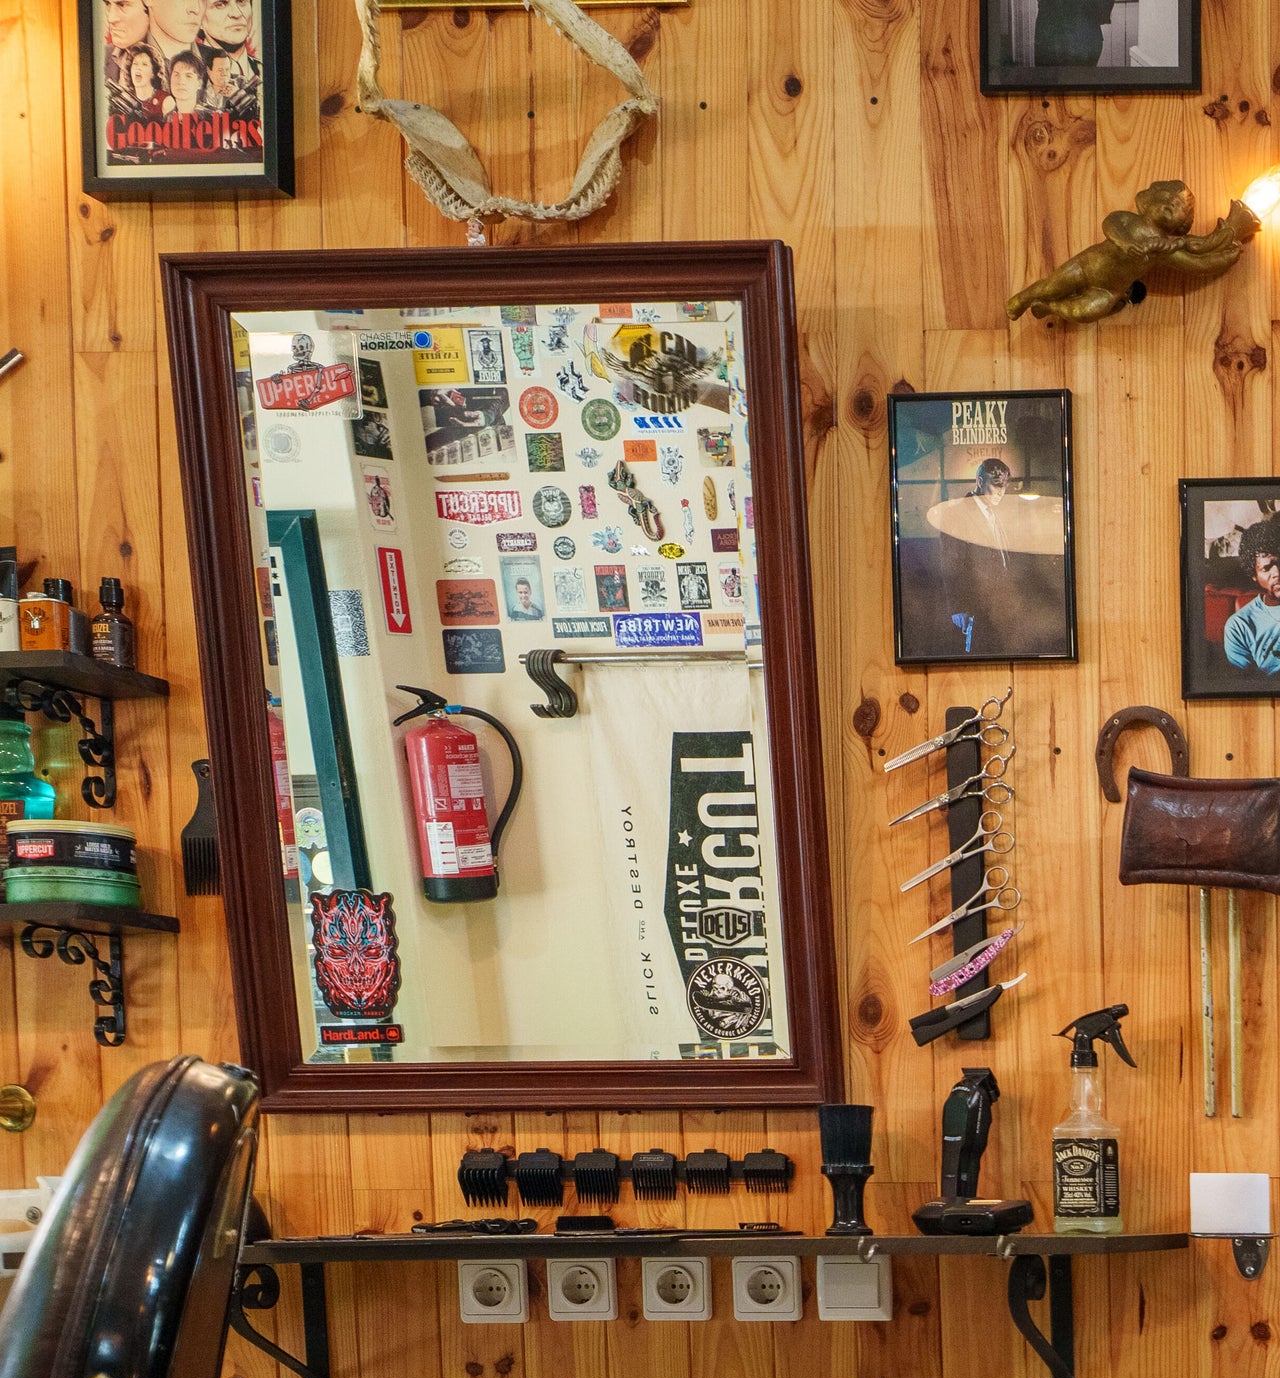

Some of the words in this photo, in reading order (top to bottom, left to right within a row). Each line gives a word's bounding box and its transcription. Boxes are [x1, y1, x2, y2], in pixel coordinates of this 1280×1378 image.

[106, 112, 263, 152] GoodFellas
[360, 332, 390, 341] CHASE
[392, 331, 412, 340] THE
[360, 340, 414, 350] HORIZON
[260, 367, 348, 406] UPPERCUT
[952, 401, 1008, 428] PEAKY
[952, 428, 1007, 445] BLINDERS
[17, 844, 53, 855] UPPERCUT
[704, 912, 747, 941] DEUS
[693, 962, 761, 996] NEVERMIND
[1055, 1149, 1073, 1163] JACK
[1072, 1145, 1100, 1163] DANIEL'S
